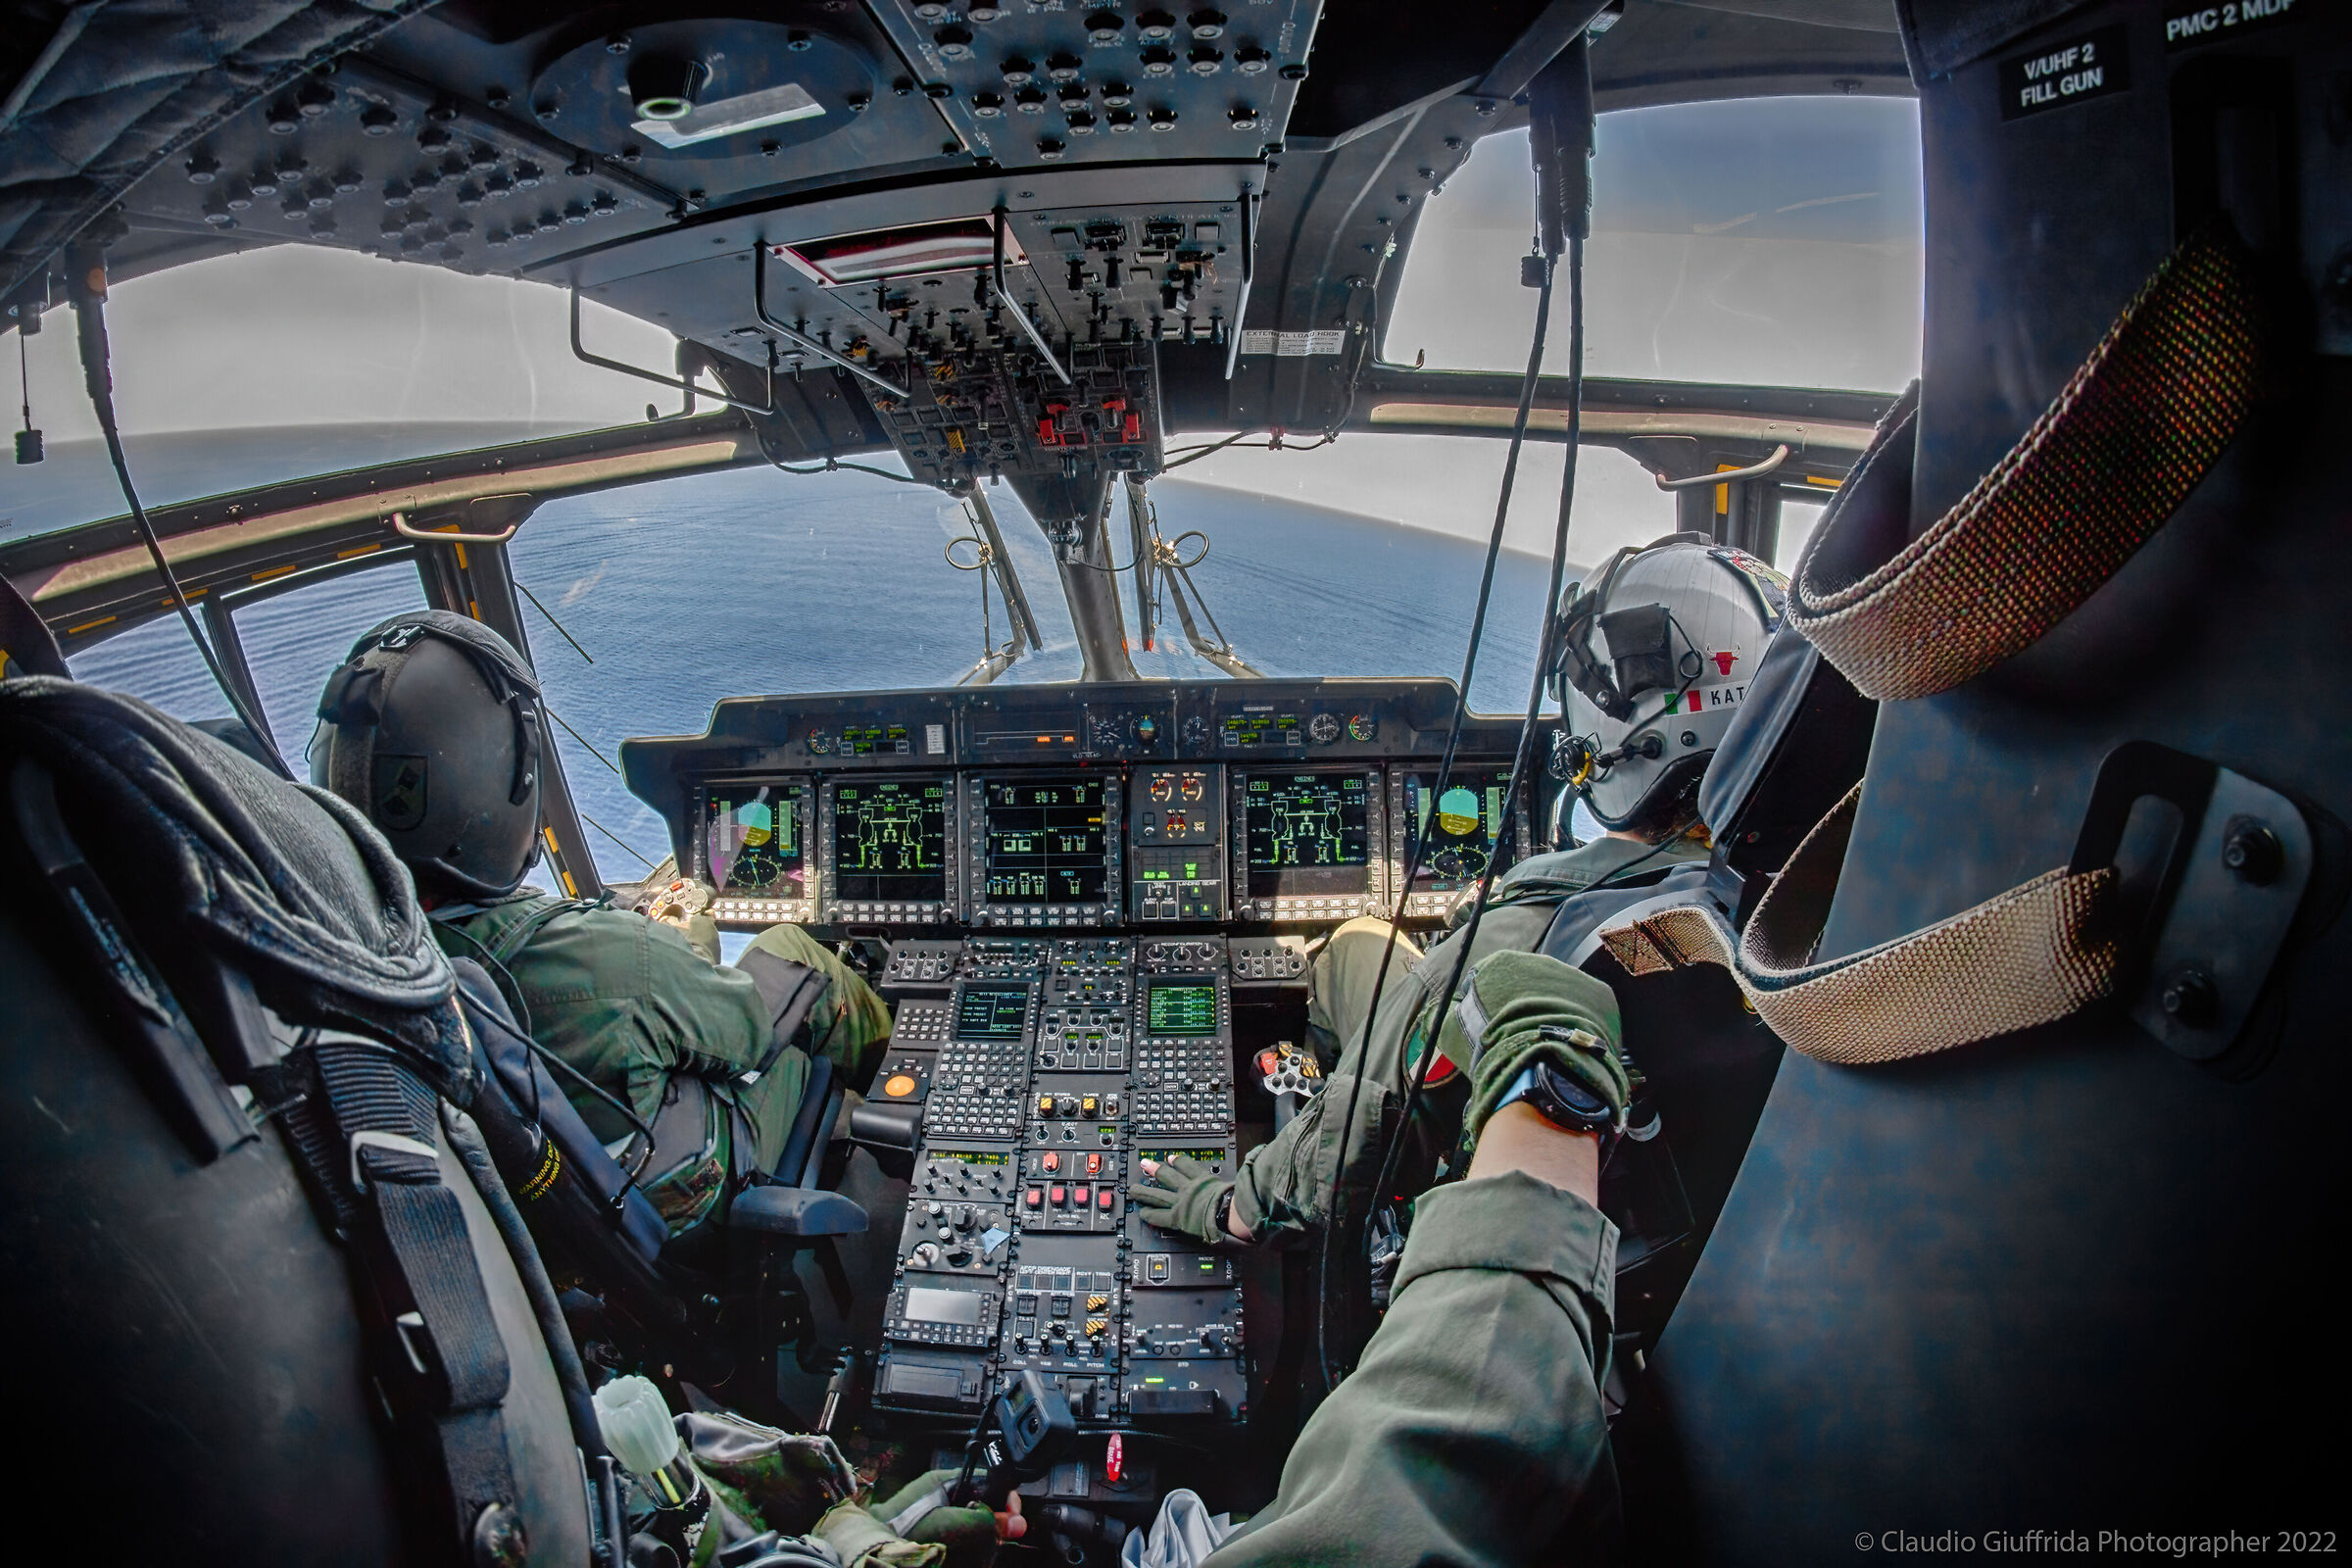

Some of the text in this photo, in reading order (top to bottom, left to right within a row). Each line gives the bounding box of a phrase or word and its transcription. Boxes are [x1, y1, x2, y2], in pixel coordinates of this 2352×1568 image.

[2167, 8, 2219, 41] PMC
[2223, 3, 2238, 26] 2
[2024, 42, 2095, 80] V/UHF 2
[2021, 66, 2104, 108] FILL GUN
[1710, 686, 1743, 705] KAT
